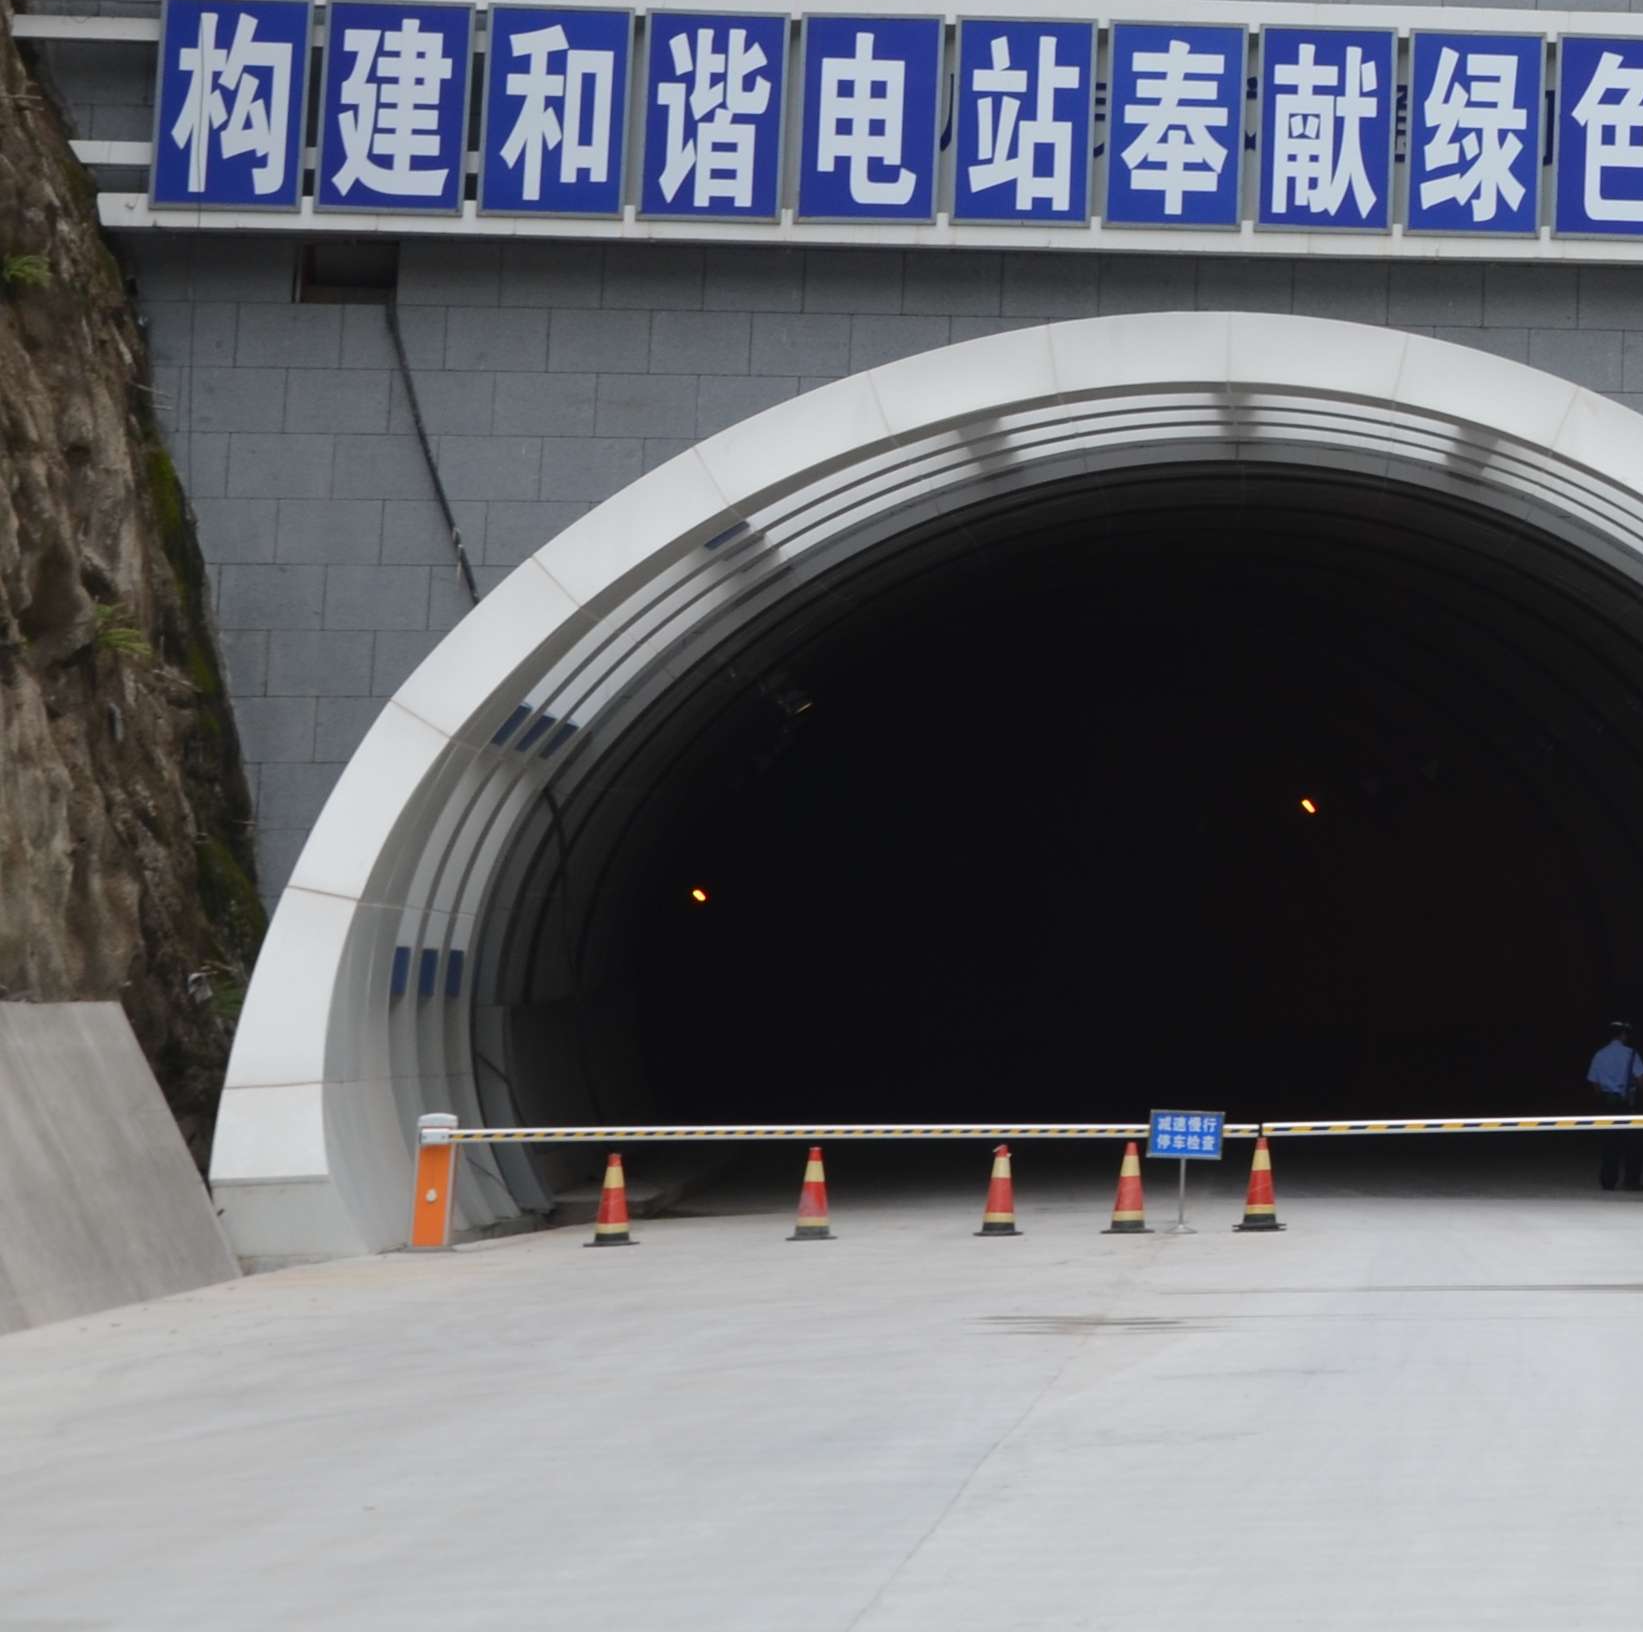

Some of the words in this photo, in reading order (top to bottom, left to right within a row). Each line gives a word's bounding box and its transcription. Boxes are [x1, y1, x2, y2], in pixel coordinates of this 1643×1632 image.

[1156, 1116, 1218, 1133] 减速慢行
[1156, 1134, 1216, 1151] 停车检查
